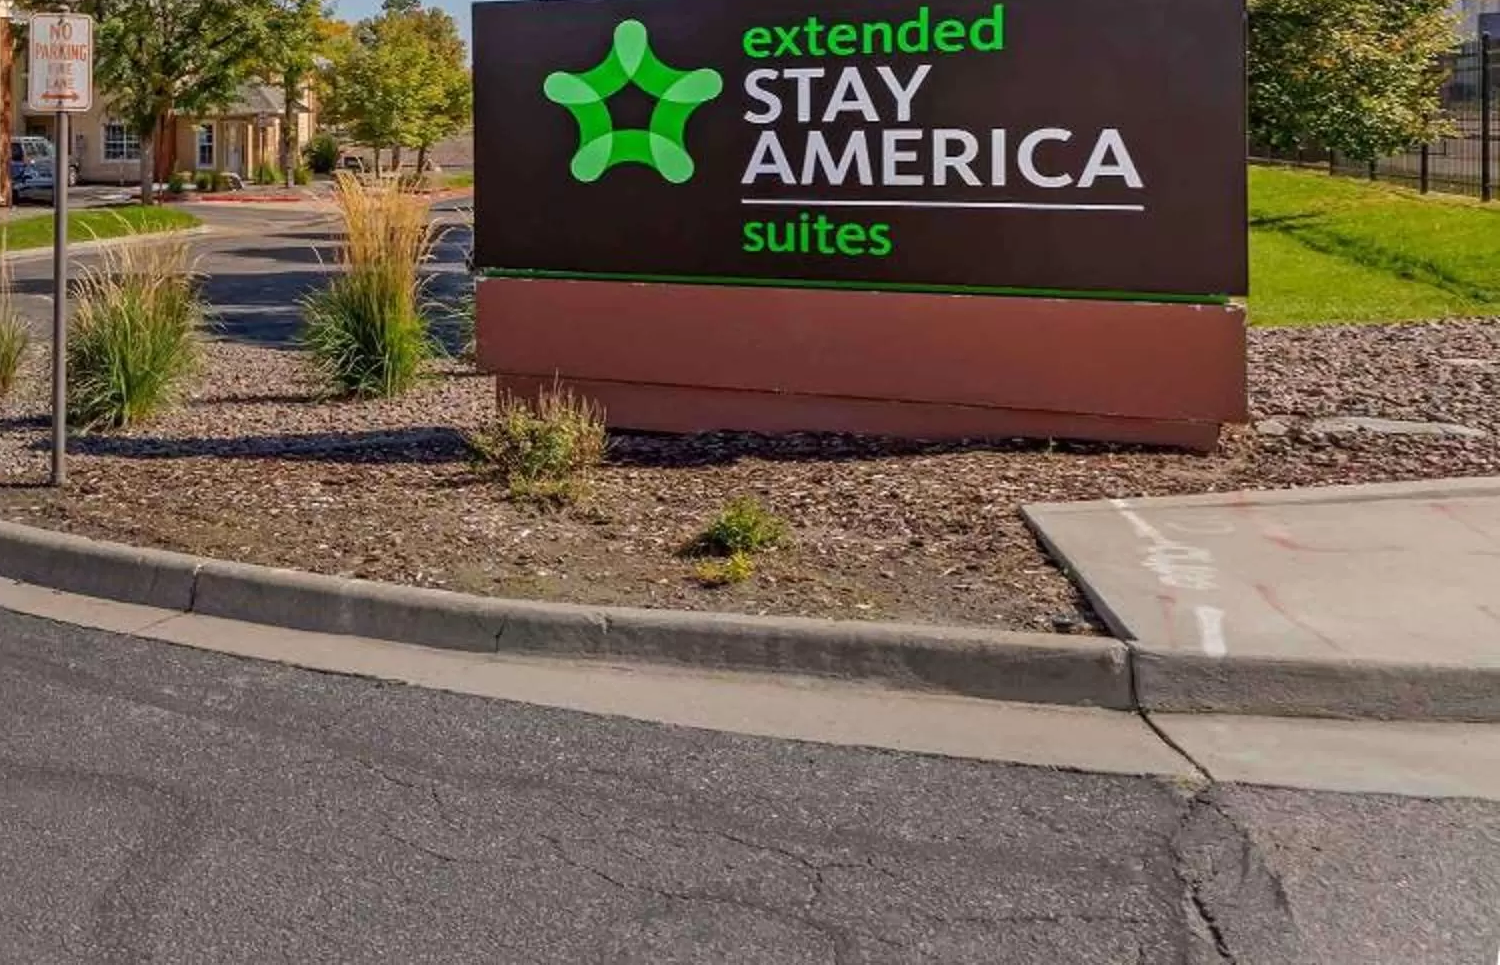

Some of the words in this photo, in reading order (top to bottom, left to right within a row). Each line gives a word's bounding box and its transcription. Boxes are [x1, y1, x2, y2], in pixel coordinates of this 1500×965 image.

[35, 43, 88, 61] PARKING
[49, 23, 72, 39] NO
[744, 4, 1003, 57] extended
[744, 65, 932, 123] STAY
[742, 128, 1143, 188] AMERICA
[745, 214, 890, 254] suites
